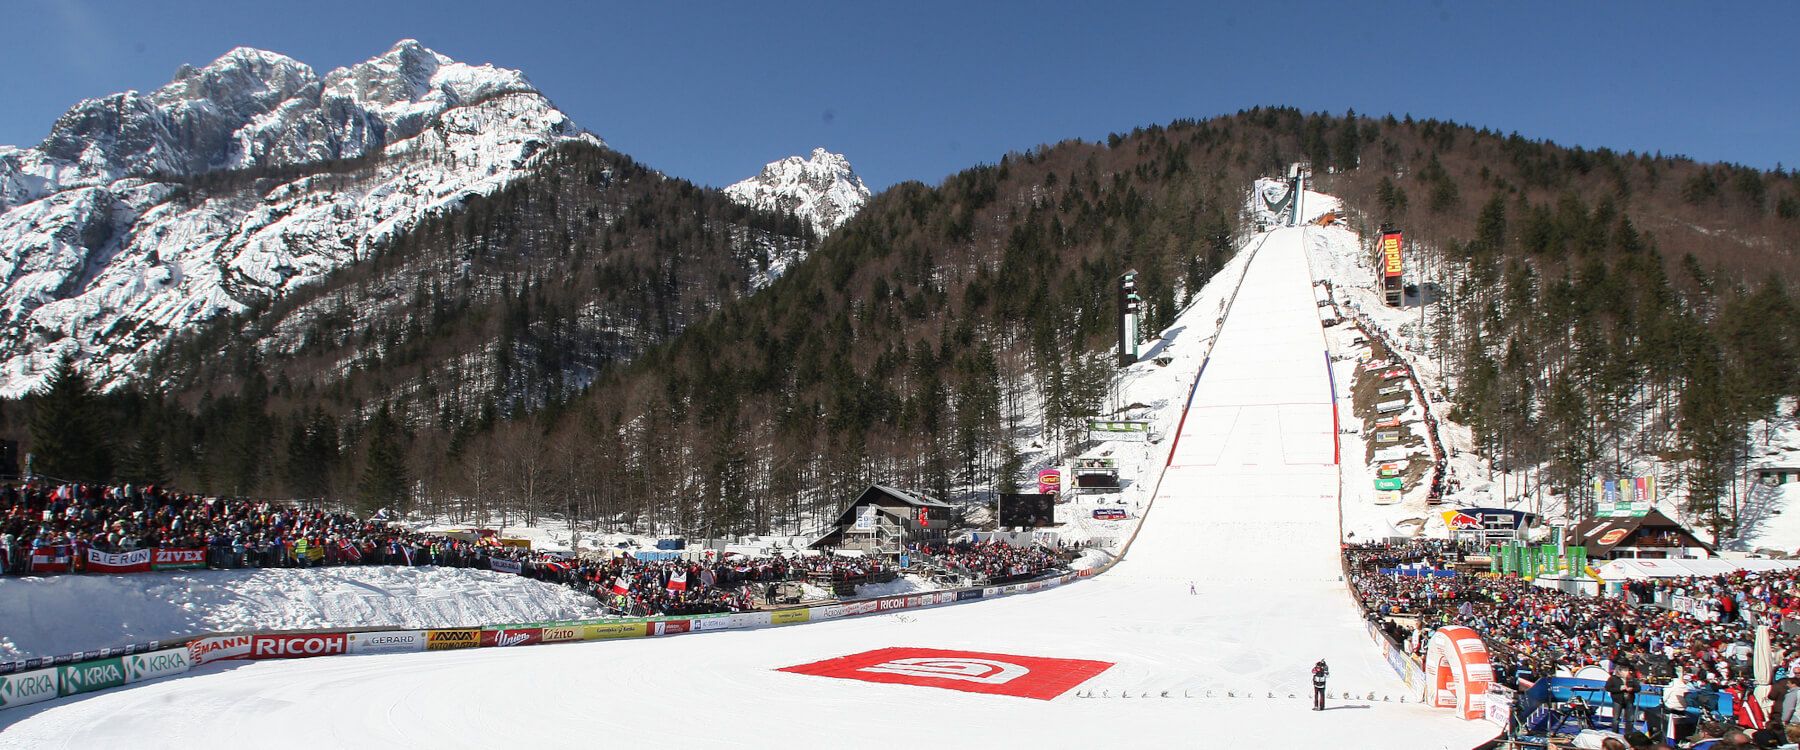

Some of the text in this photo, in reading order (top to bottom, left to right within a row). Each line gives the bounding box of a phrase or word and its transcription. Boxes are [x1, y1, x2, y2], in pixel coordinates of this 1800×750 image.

[1385, 239, 1401, 273] Cockta
[880, 599, 904, 610] RICOH
[256, 638, 342, 655] RICOH
[372, 636, 414, 644] GERARD
[494, 630, 530, 646] Union
[150, 652, 187, 672] KRKA
[84, 664, 122, 686] KRKA
[17, 674, 55, 698] KRKA
